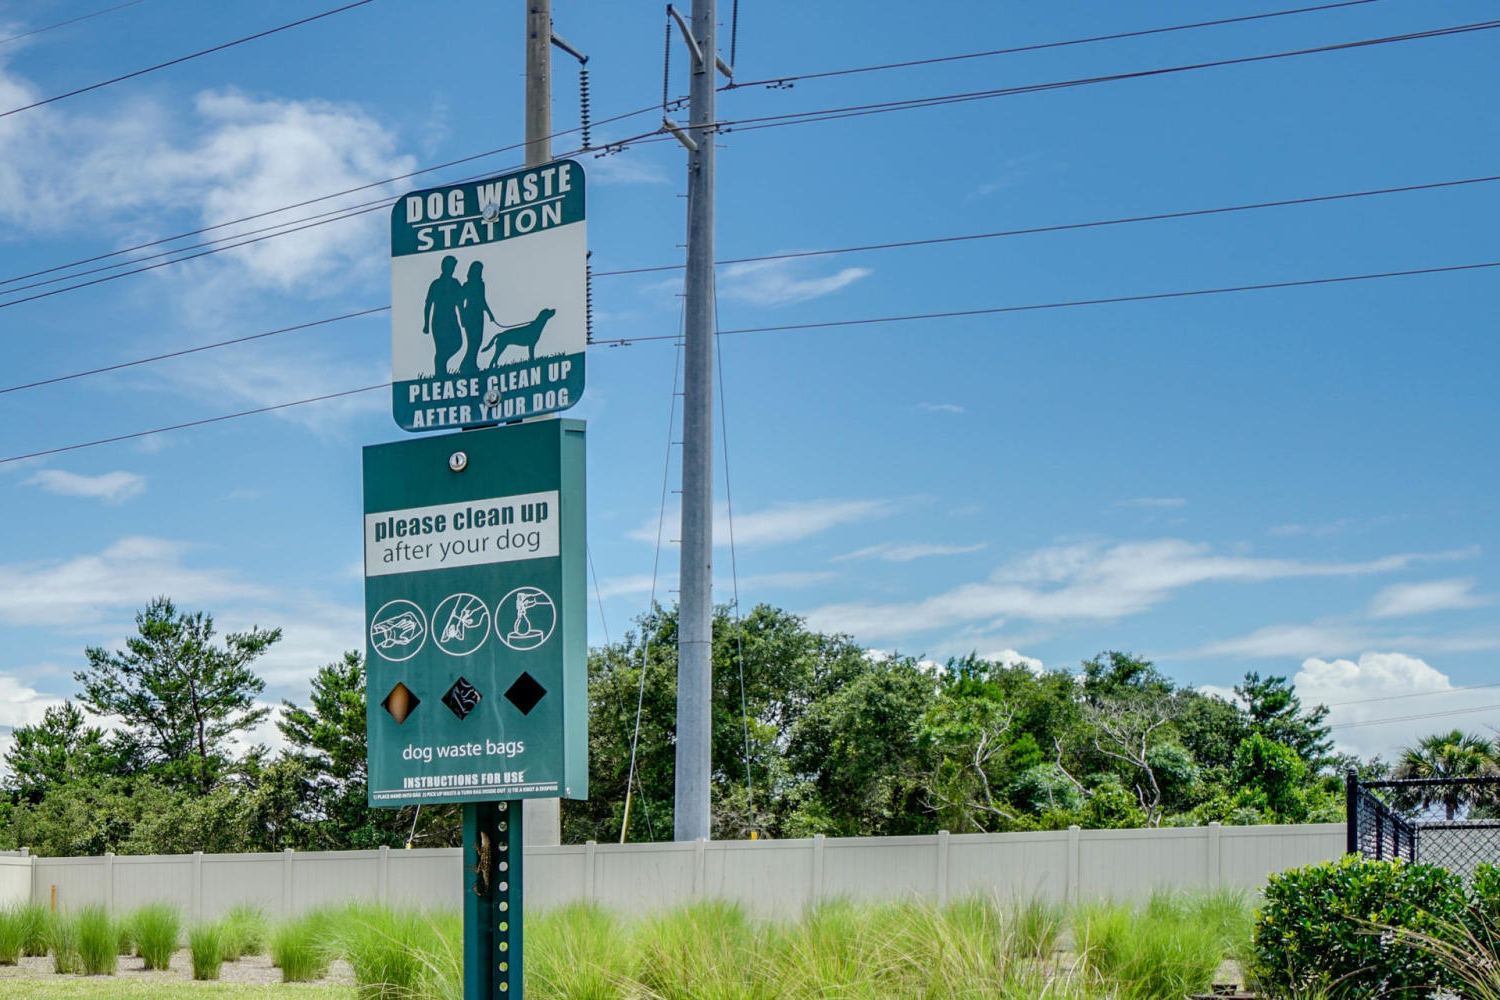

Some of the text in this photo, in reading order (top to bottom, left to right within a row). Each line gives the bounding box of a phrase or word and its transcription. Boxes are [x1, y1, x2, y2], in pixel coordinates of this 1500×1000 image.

[406, 164, 571, 224] DOG WASTE
[417, 201, 562, 251] STATION
[409, 360, 572, 403] PLEASE CLEAN UP
[413, 387, 569, 429] AFTER YOUR DOG
[375, 501, 548, 542] please clean up
[383, 529, 540, 563] after your dog
[402, 738, 524, 763] dog waste bags
[403, 771, 524, 789] INSTRUCTIONS FOR USE
